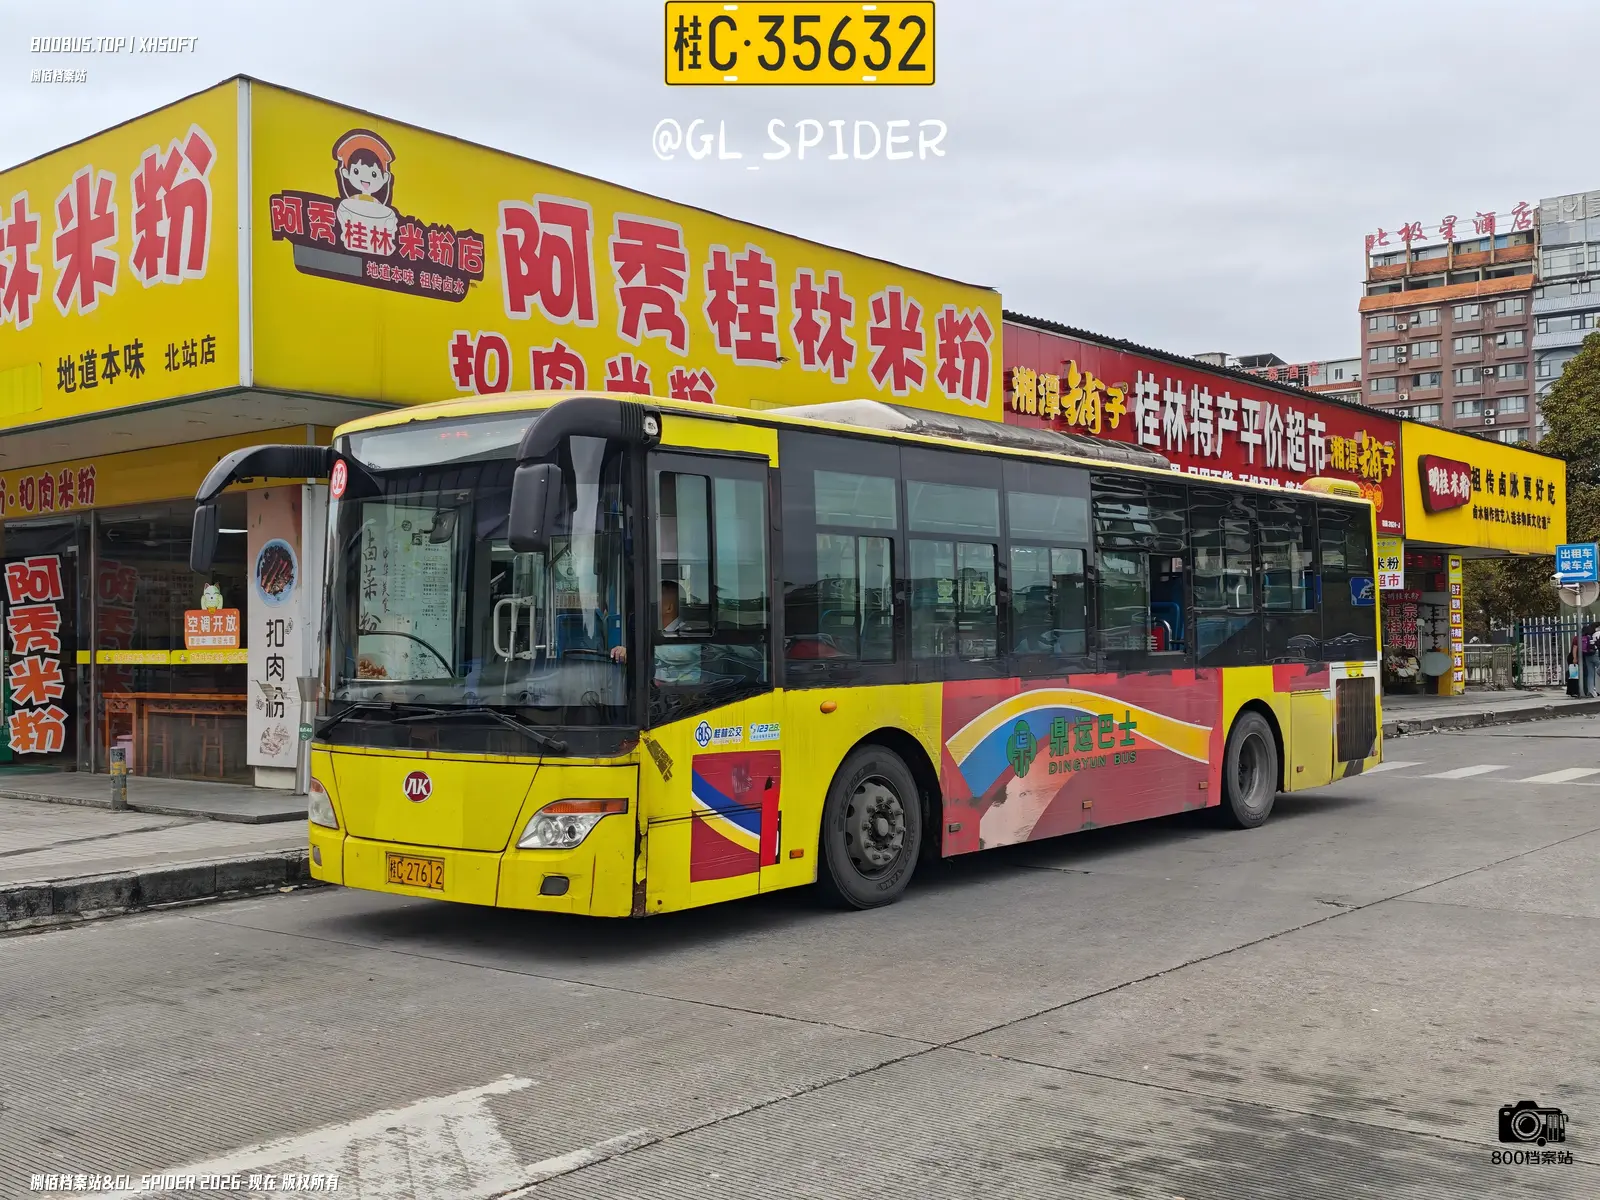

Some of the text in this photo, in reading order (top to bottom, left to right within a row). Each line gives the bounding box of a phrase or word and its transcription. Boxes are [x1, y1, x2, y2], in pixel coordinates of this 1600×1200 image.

[270, 196, 485, 274] 阿秀桂林米粉店
[1365, 201, 1533, 249] 北极星酒店
[366, 261, 465, 294] 地道本味 祖传卤水
[498, 193, 995, 408] 阿秀桂林米粉
[56, 333, 217, 394] 地道本味 北站店
[1134, 370, 1327, 476] 桂林特产平价超市
[332, 465, 345, 490] 32
[1560, 548, 1593, 559] 出租车
[1560, 559, 1594, 571] 候车点
[1387, 603, 1418, 619] 正宗
[187, 615, 238, 634] 空调开放
[1387, 618, 1418, 634] 桂林
[1388, 634, 1418, 650] 米粉
[4, 554, 70, 756] 阿秀米粉
[713, 726, 743, 739] 桂林公交
[1049, 709, 1138, 758] 鼎运巴士
[1048, 751, 1138, 776] DINGYUN BUS
